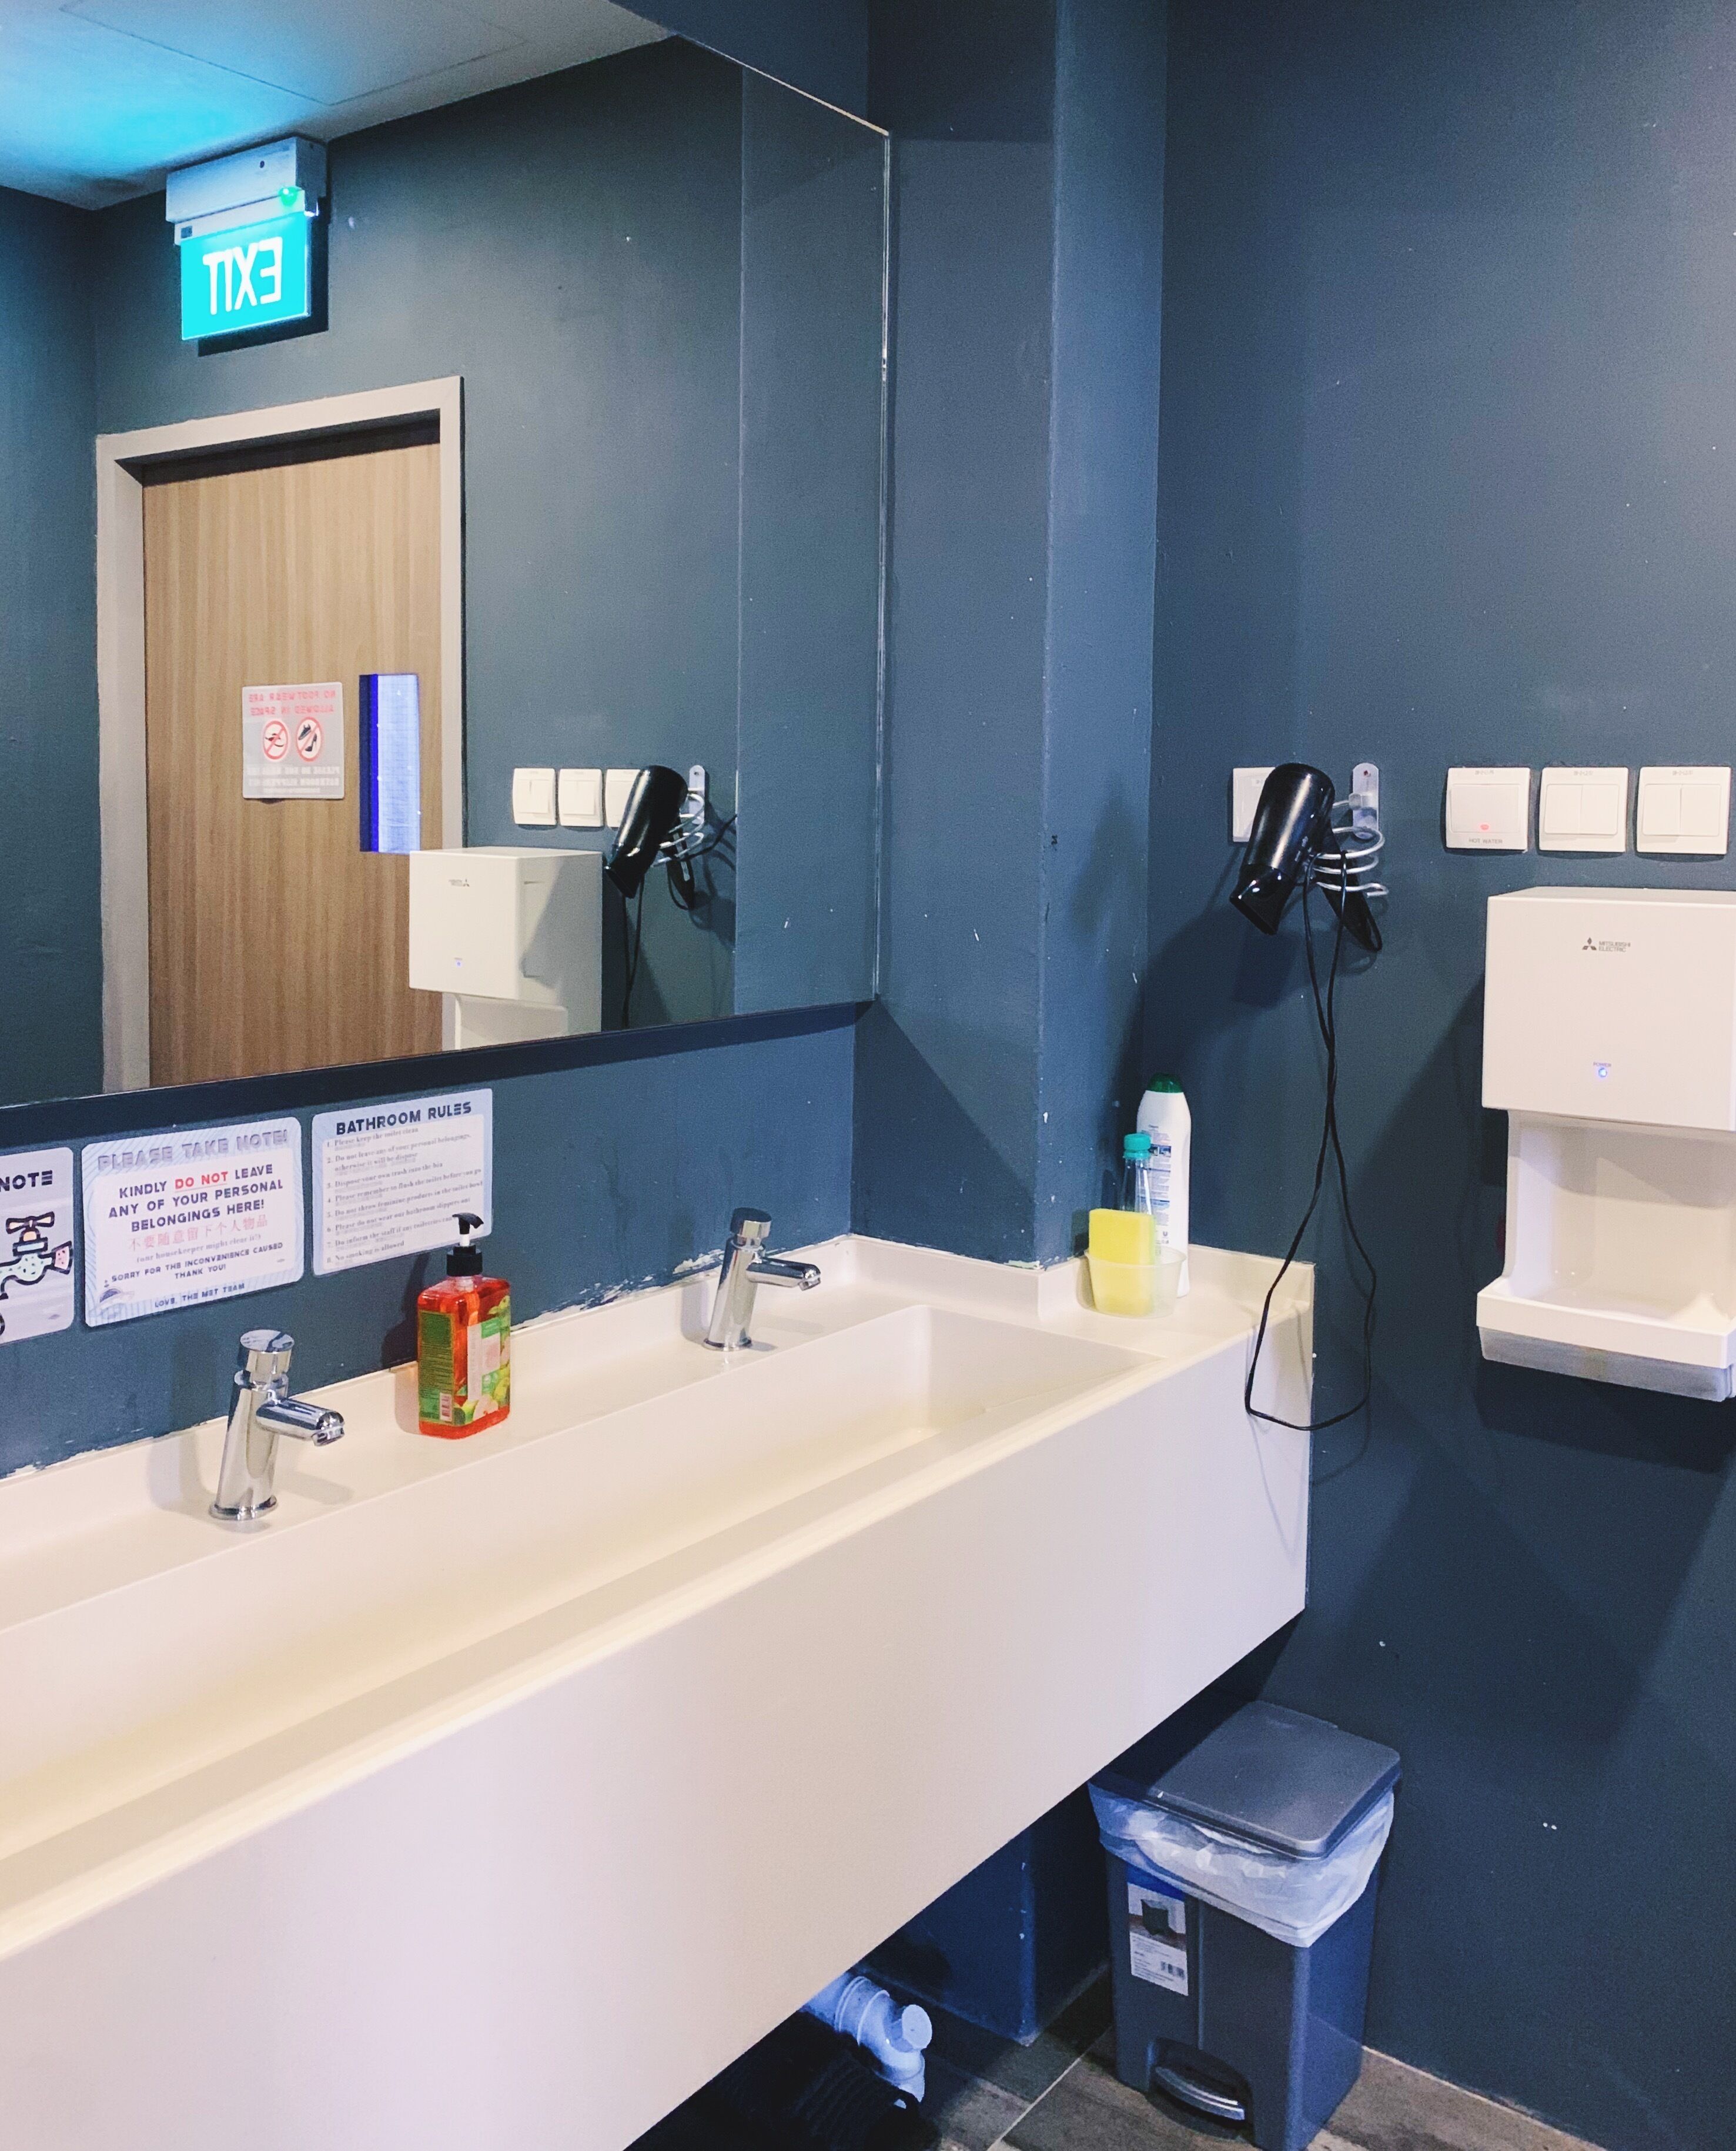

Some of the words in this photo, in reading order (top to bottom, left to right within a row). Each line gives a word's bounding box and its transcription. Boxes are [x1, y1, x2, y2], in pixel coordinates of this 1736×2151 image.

[336, 1109, 421, 1135] BATHROOM
[428, 1101, 472, 1120] RULES
[97, 1145, 173, 1171] PLEASE
[182, 1138, 229, 1157] TAKE
[236, 1129, 287, 1151] NOTE!
[335, 1138, 356, 1147] Please
[384, 1129, 401, 1137] toilet
[411, 1138, 436, 1151] personal
[335, 1162, 366, 1171] otherwise
[335, 1178, 361, 1188] Dispose
[392, 1168, 407, 1177] trash
[119, 1181, 168, 1198] KINDLY
[175, 1177, 194, 1190] DO
[201, 1171, 228, 1185] NOT
[235, 1164, 273, 1180] LEAVE
[357, 1187, 389, 1197] remember
[399, 1181, 414, 1190] flush
[378, 1198, 405, 1207] feminine
[407, 1192, 433, 1203] products
[469, 1180, 483, 1188] bowl
[108, 1203, 139, 1218] ANY
[146, 1198, 165, 1211] OF
[172, 1192, 208, 1207] YOUR
[215, 1179, 284, 1201] PERSONAL
[131, 1207, 220, 1232] BELONGINGS
[227, 1199, 265, 1215] HERE!
[335, 1223, 355, 1231] Please
[406, 1205, 435, 1215] bathroom
[436, 1200, 460, 1209] slippers
[346, 1235, 369, 1244] inform
[381, 1227, 396, 1235] staff
[414, 1218, 441, 1227] toiletries
[156, 1244, 203, 1260] housekeeper
[206, 1240, 228, 1251] might
[229, 1235, 247, 1245] clear
[346, 1250, 373, 1259] smoking
[382, 1240, 404, 1251] allowed
[112, 1271, 141, 1282] SORRY
[145, 1267, 161, 1275] FOR
[165, 1262, 181, 1271] THE
[185, 1249, 250, 1268] INCONVENIENCE
[253, 1242, 283, 1254] CAUSED
[175, 1268, 203, 1280] THANK
[208, 1264, 227, 1272] YOU!
[182, 1292, 199, 1301] THE
[202, 1288, 219, 1298] MET
[223, 1283, 245, 1294] TEAM
